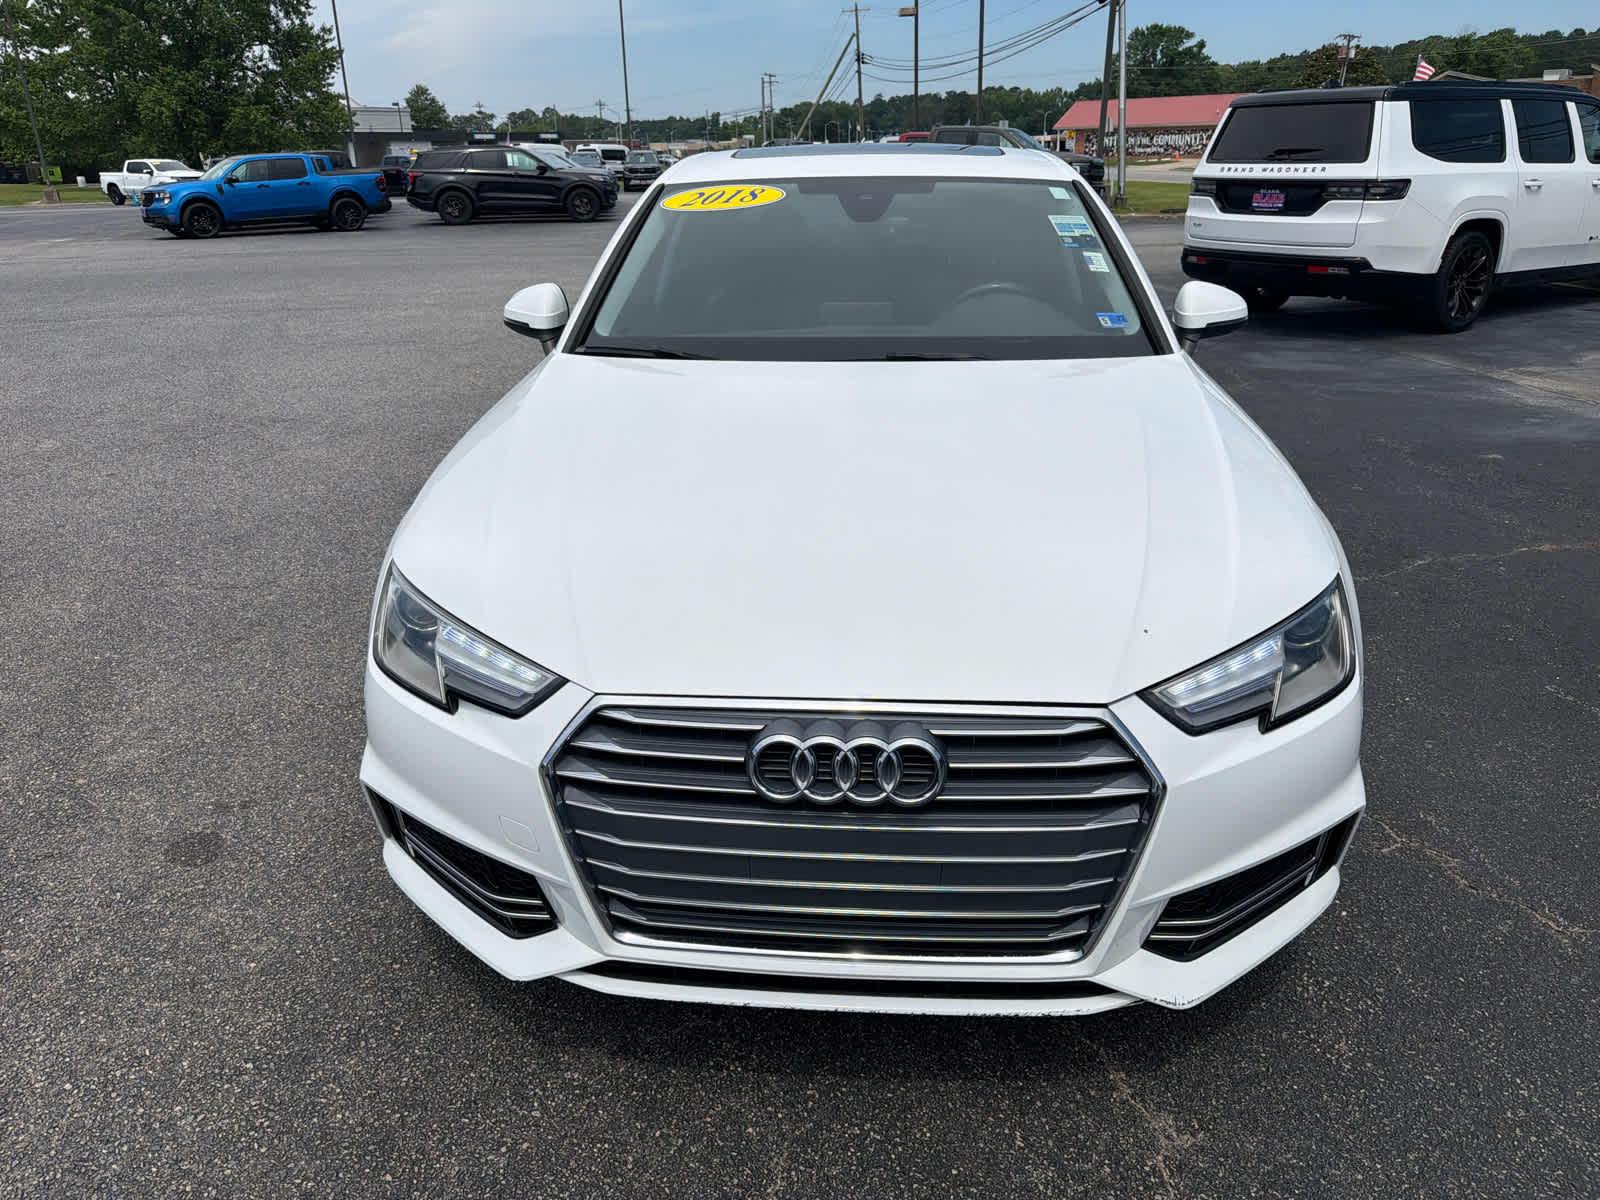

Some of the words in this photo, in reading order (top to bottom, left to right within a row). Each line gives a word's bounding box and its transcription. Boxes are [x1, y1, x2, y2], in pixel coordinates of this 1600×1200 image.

[1153, 132, 1209, 147] COMMUNITY
[1219, 166, 1255, 174] GRAND
[1261, 165, 1328, 174] WAGONEER
[679, 187, 766, 208] 2018
